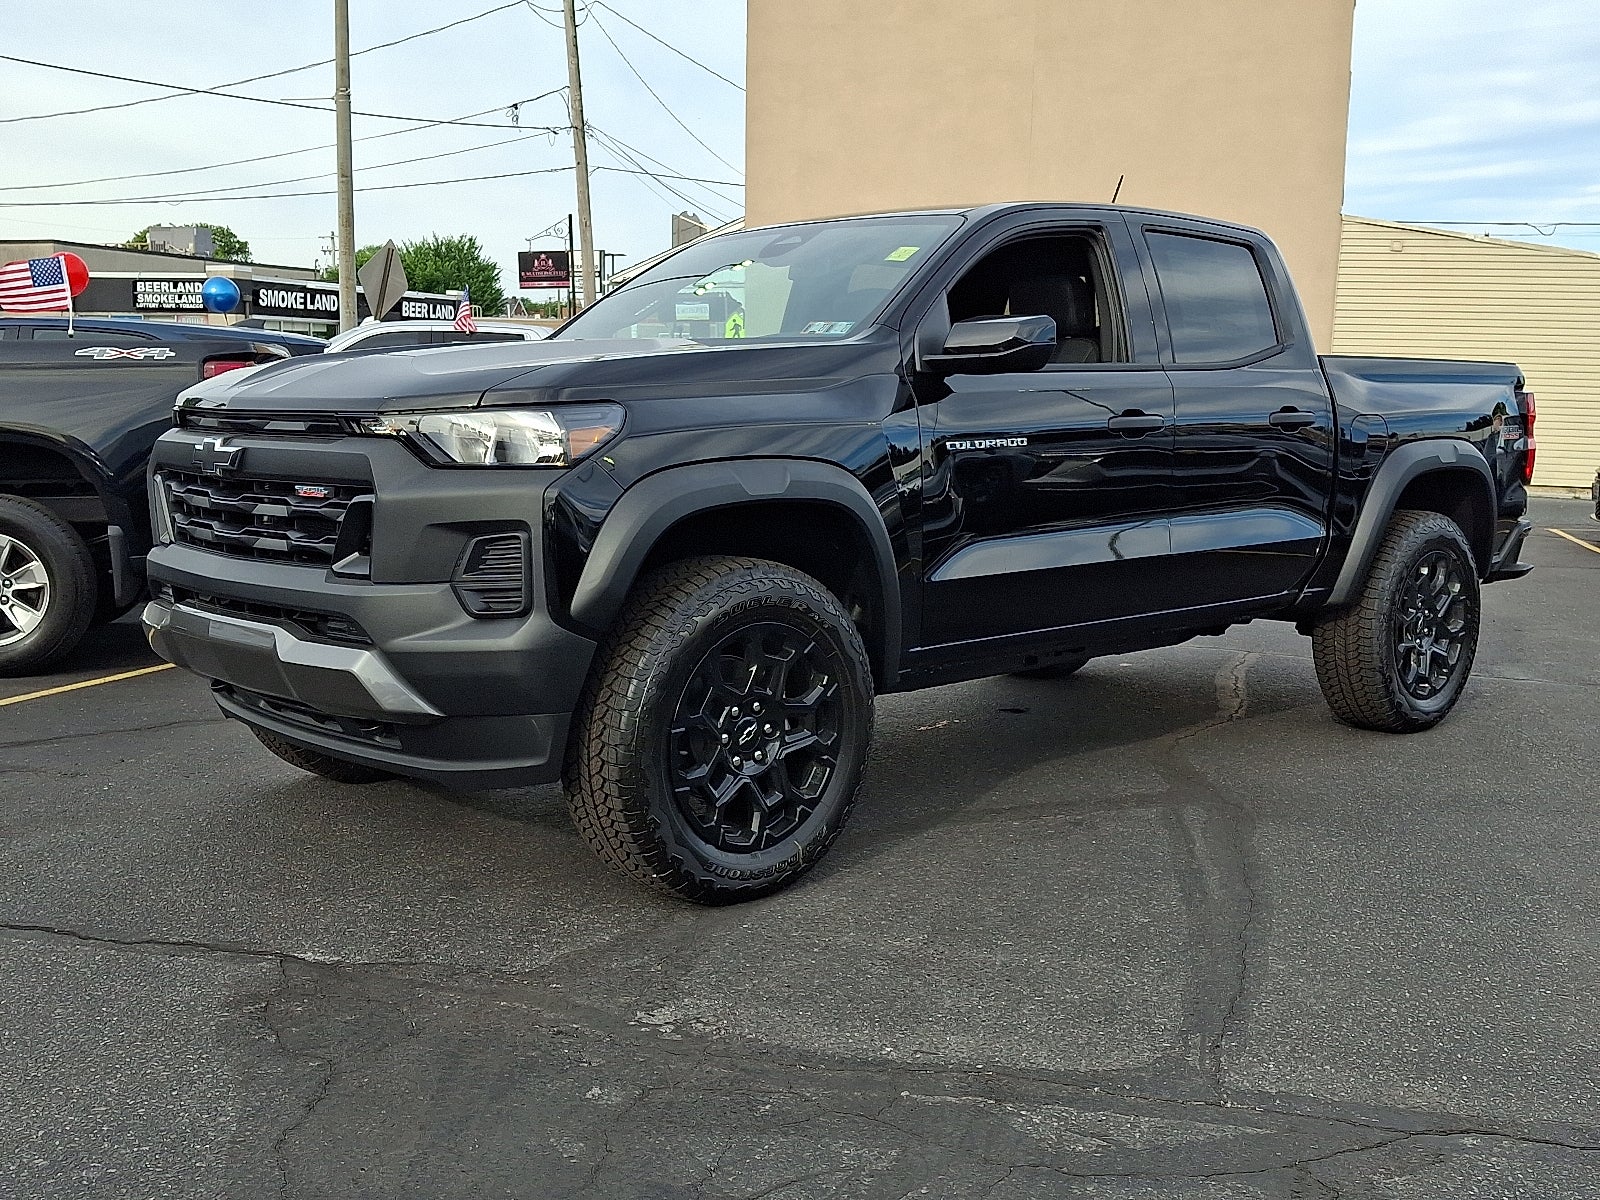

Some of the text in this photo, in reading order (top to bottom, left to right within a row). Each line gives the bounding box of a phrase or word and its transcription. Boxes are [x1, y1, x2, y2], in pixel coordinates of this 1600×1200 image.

[136, 281, 203, 293] BEERLAND
[136, 293, 204, 304] SMOKELAND
[258, 288, 339, 312] SMOKE LAND
[401, 300, 455, 320] BEER LAND
[945, 437, 1029, 451] COLORADO
[713, 595, 808, 630] DUELER
